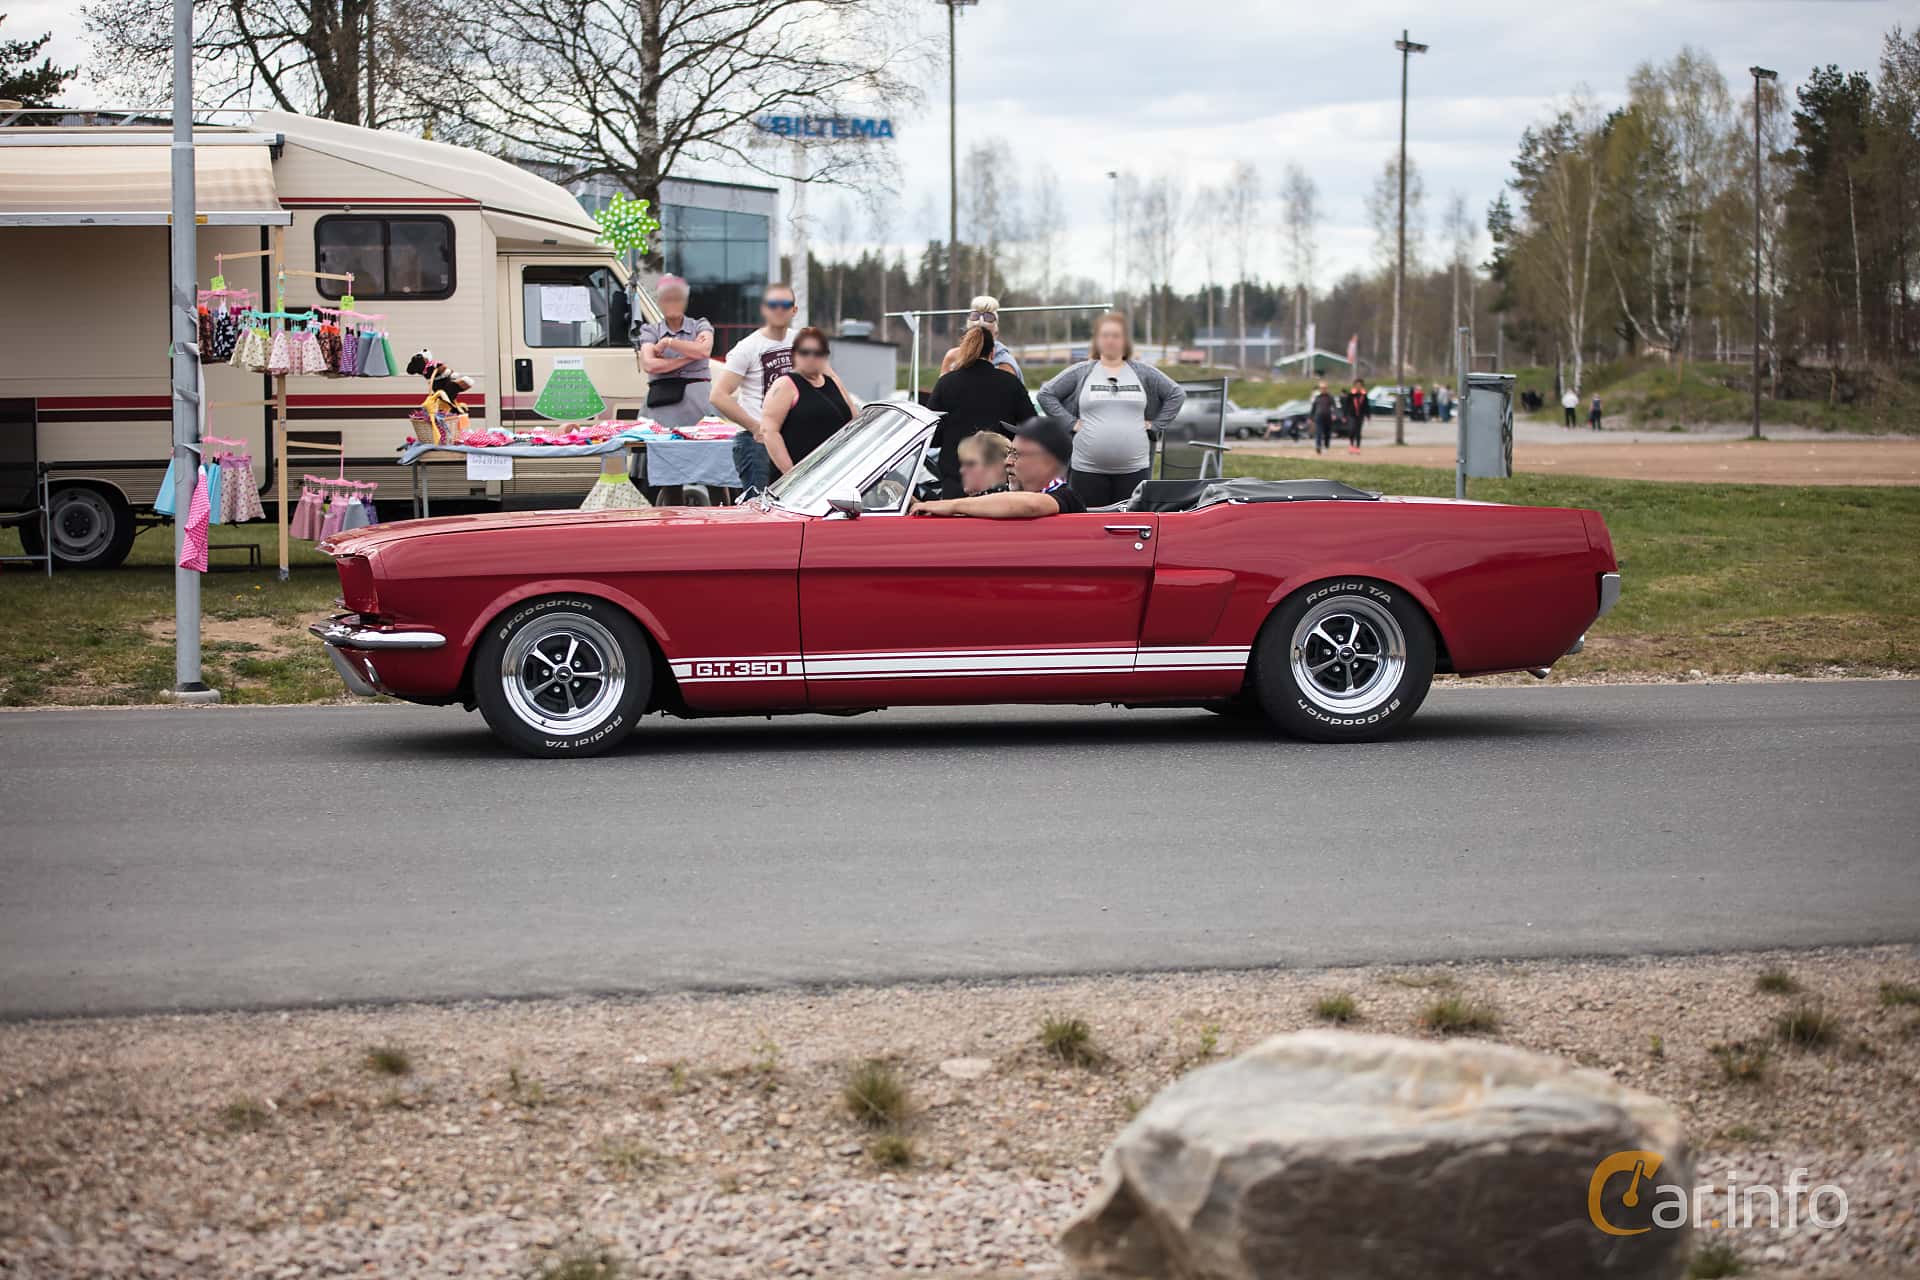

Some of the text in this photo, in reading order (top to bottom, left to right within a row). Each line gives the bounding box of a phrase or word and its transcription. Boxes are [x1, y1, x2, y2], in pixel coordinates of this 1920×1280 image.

[770, 116, 894, 138] BILTEMA
[1306, 583, 1392, 604] Radial T/A
[499, 599, 593, 640] BFGoodrich
[1297, 698, 1401, 726] BFGoodrich
[545, 715, 623, 748] Radial T/A
